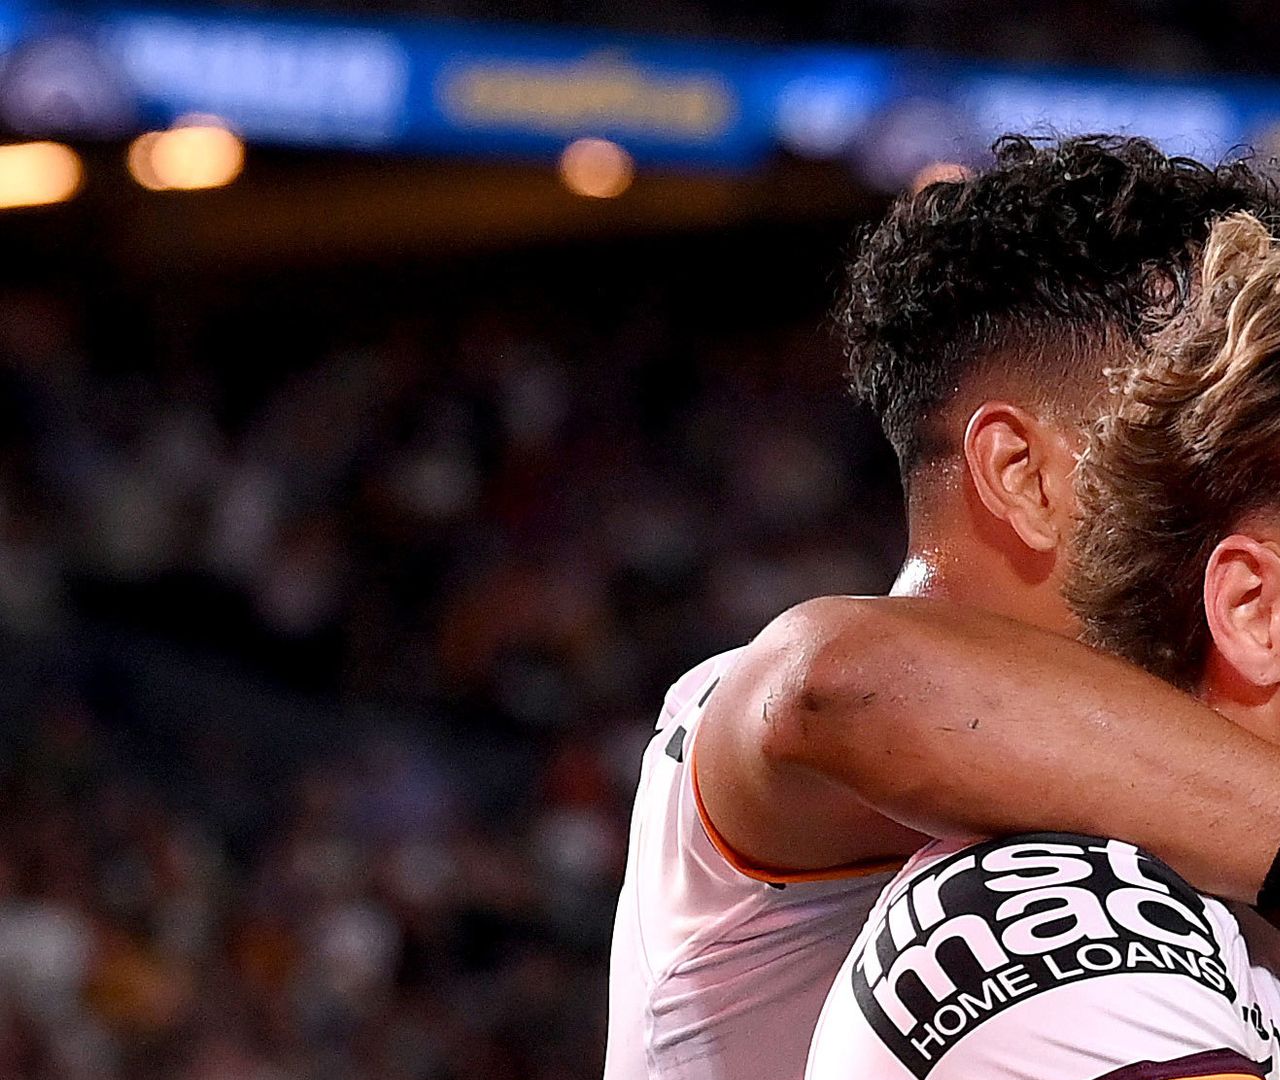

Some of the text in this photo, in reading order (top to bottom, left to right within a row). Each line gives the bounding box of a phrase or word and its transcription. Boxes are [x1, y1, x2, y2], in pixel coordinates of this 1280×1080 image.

[857, 839, 1171, 986] first
[873, 886, 1215, 1037] mac
[910, 942, 1227, 1061] HOME LOANS
